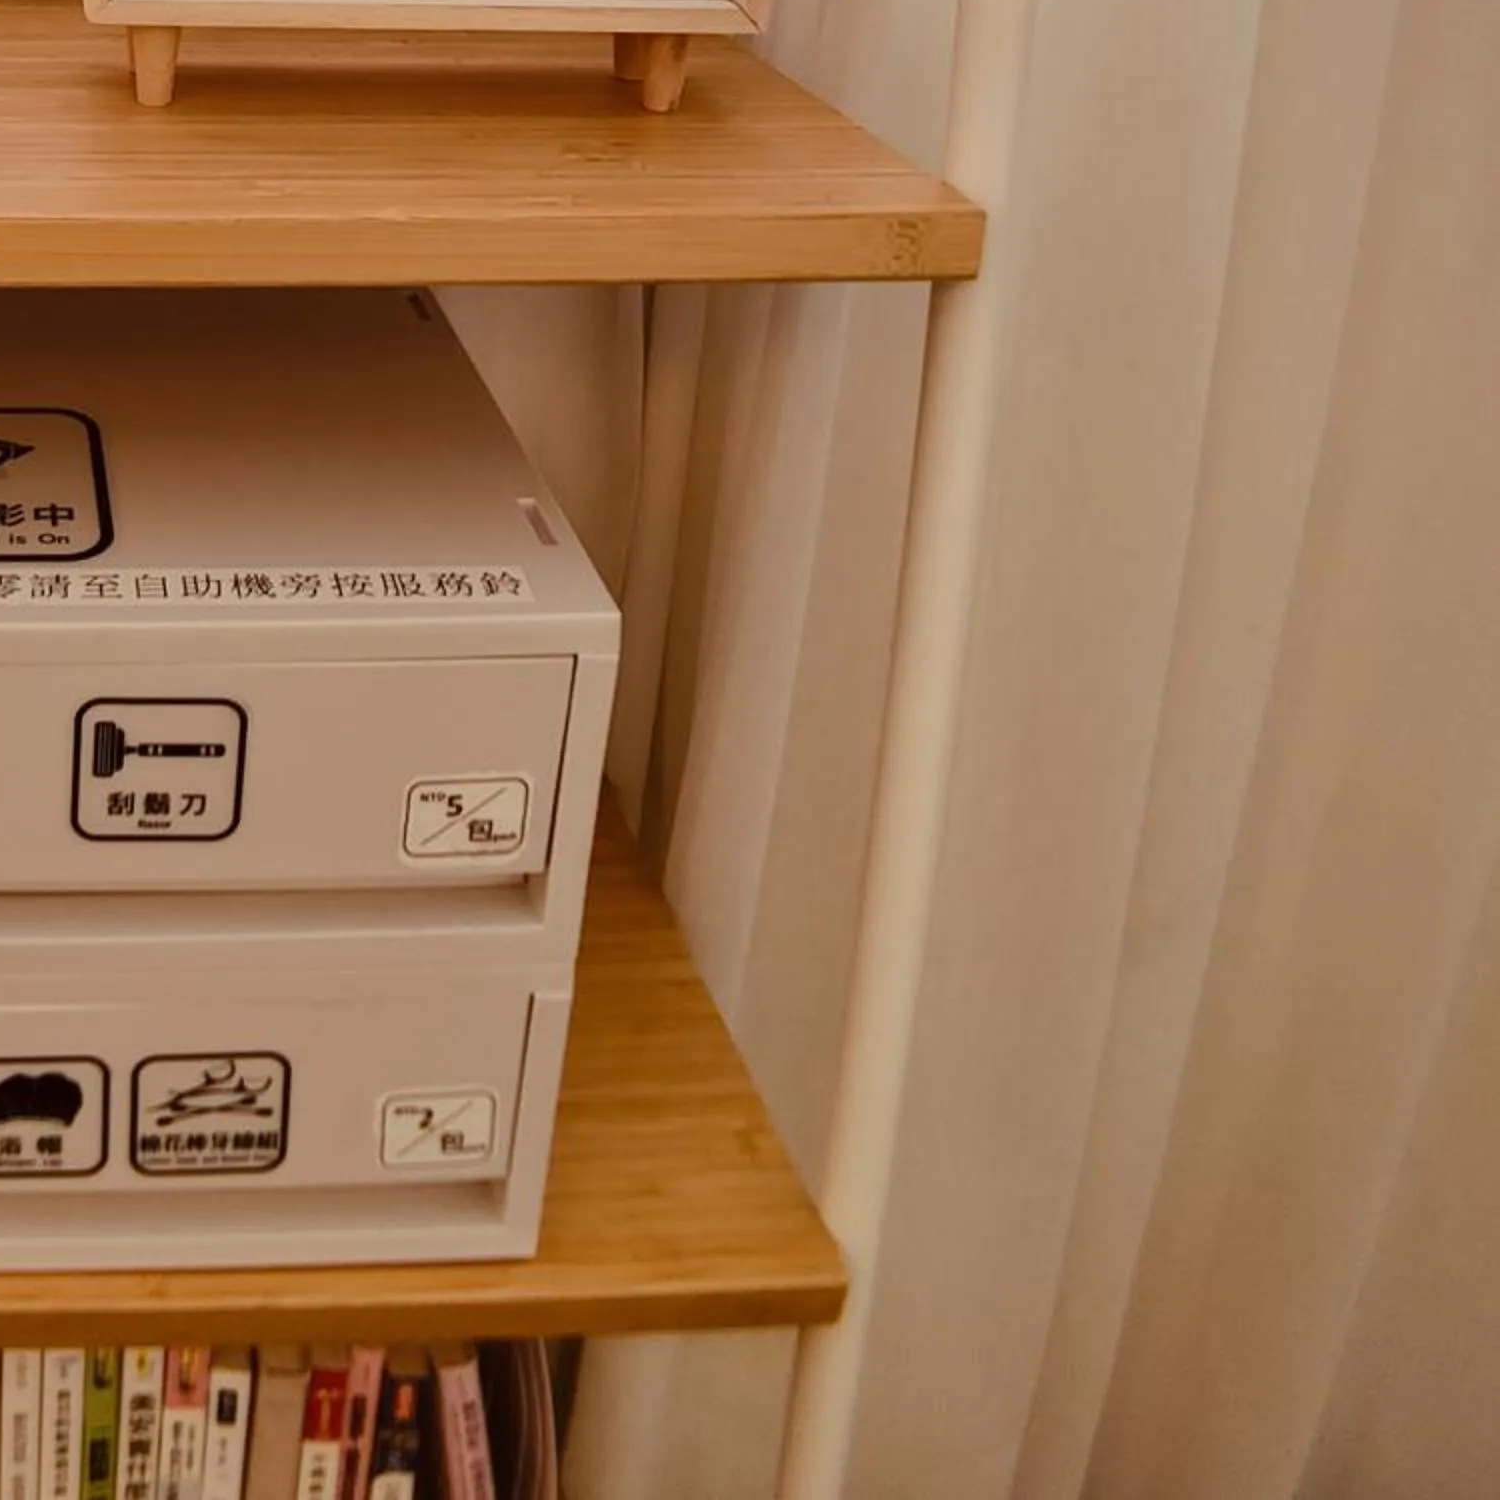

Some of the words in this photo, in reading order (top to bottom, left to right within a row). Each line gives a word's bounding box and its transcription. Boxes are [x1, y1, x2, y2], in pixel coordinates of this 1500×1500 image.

[8, 533, 28, 546] is
[38, 533, 71, 546] On
[446, 793, 464, 818] 5
